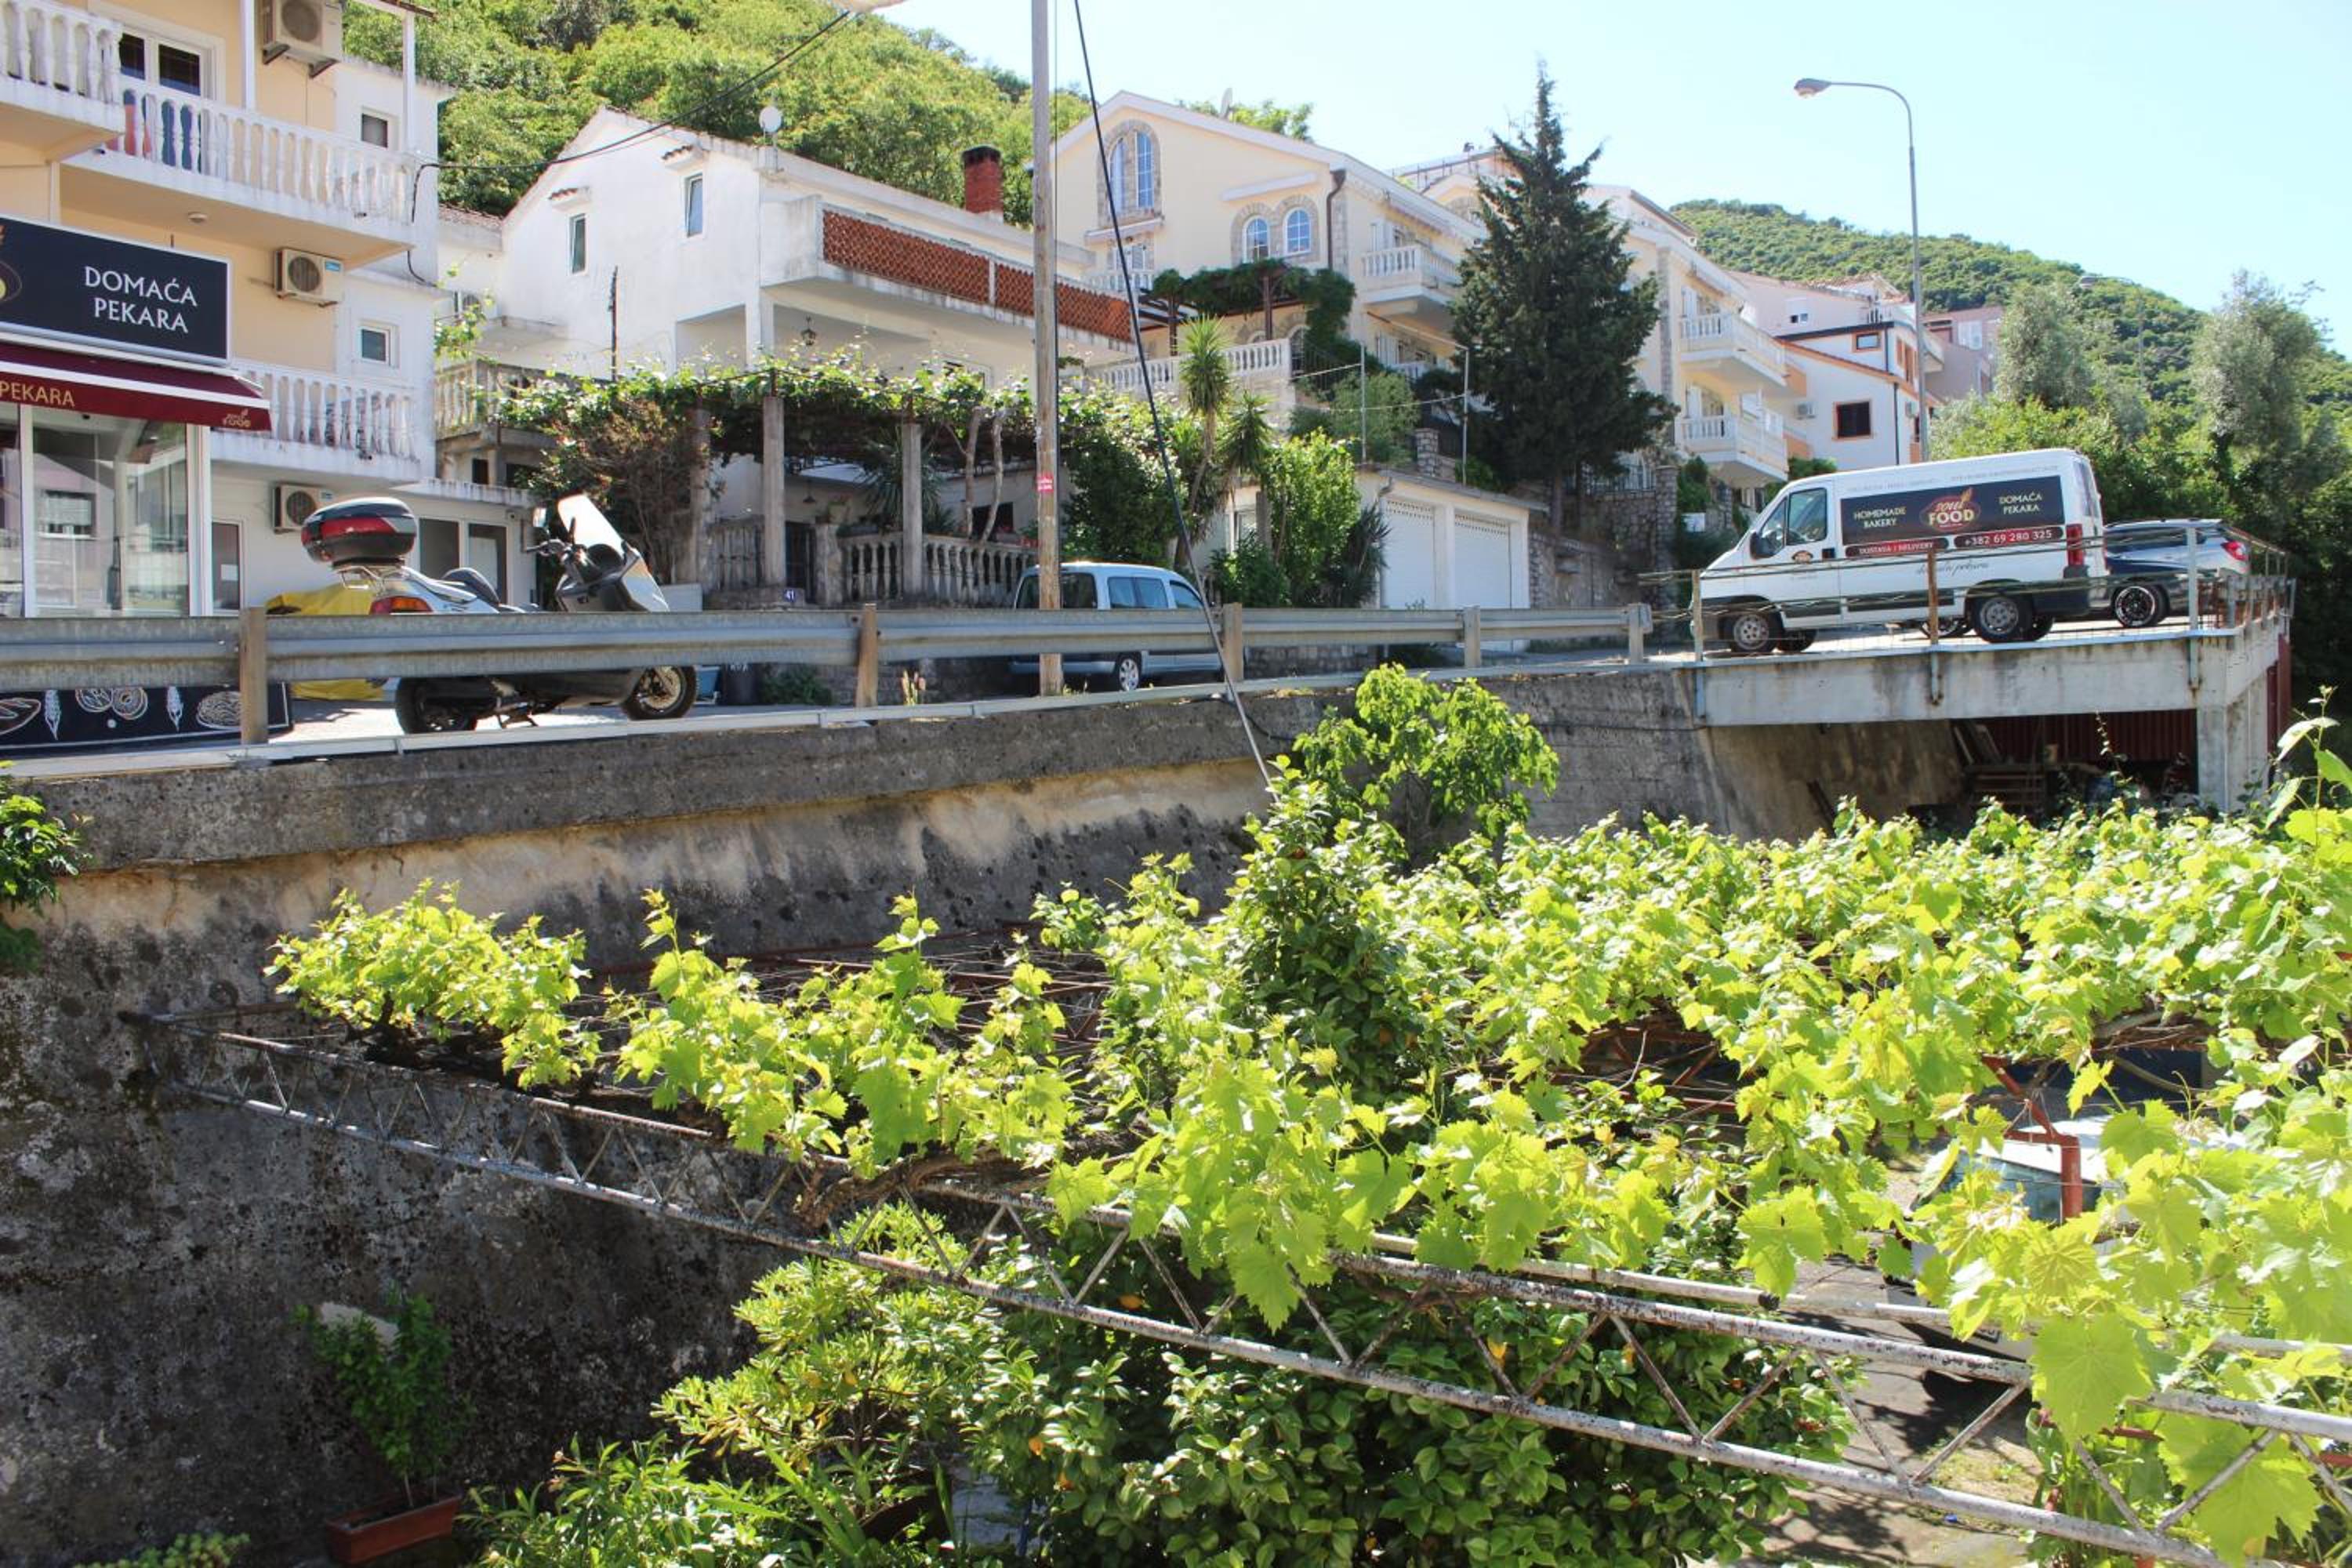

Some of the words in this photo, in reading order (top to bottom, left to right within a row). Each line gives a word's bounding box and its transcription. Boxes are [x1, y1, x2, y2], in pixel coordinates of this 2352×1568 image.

[84, 265, 198, 307] DOMAĆA
[94, 296, 189, 333] PEKARA
[0, 380, 75, 407] PEKARA
[1853, 506, 1907, 521] HOMEMADE
[1929, 509, 1975, 526] FOOD
[2003, 504, 2040, 514] PEKARA
[1864, 517, 1897, 528] BAKERY
[1965, 535, 1991, 546] +382
[1994, 534, 2006, 543] 69
[2009, 532, 2030, 542] 280
[2032, 529, 2052, 539] 325
